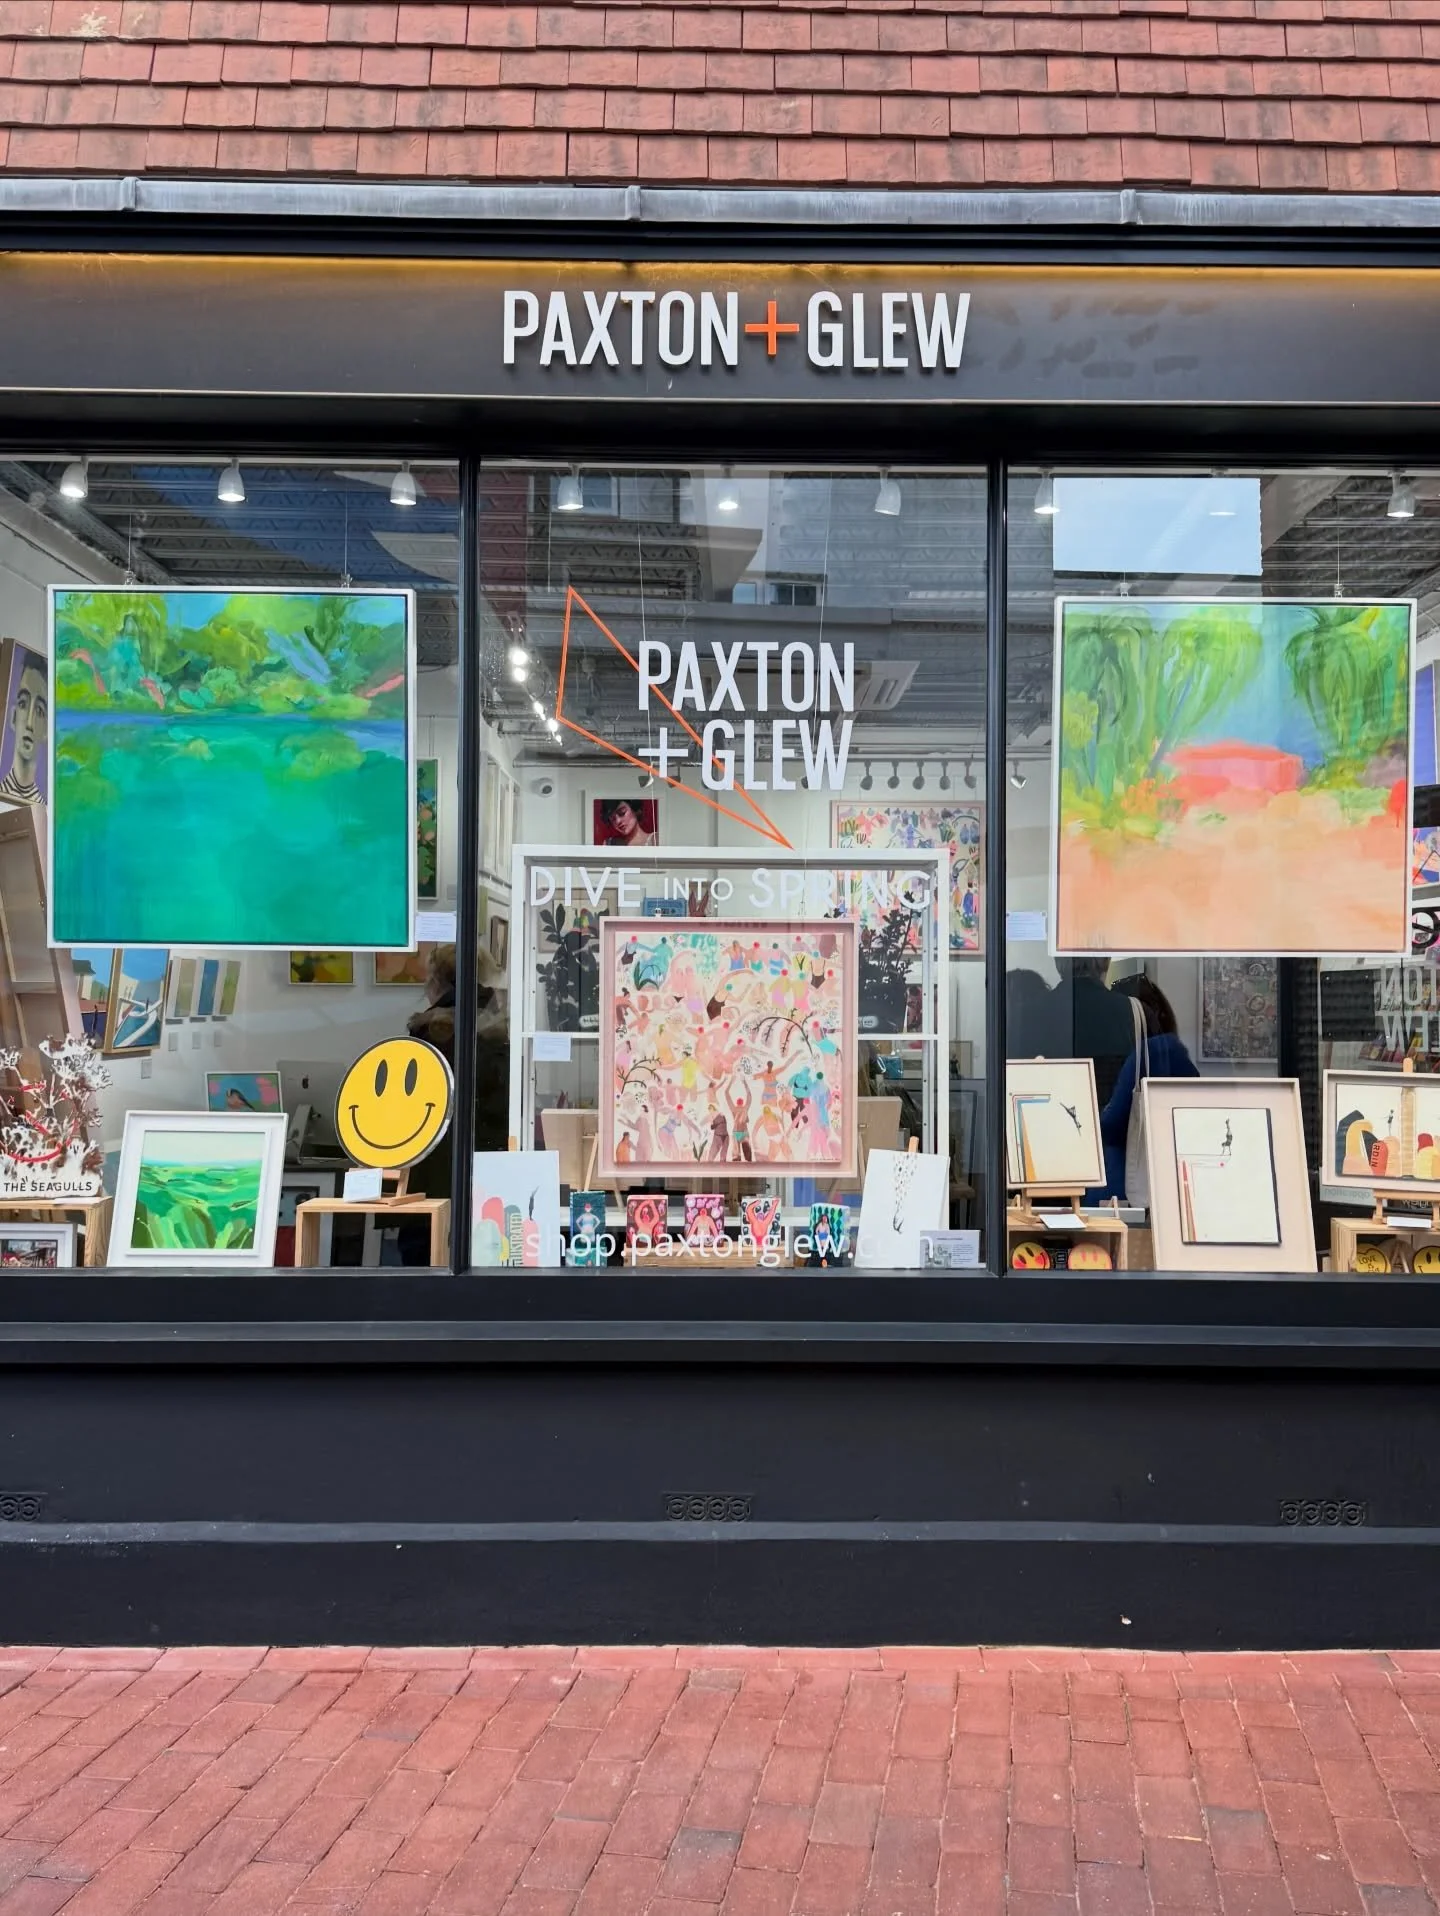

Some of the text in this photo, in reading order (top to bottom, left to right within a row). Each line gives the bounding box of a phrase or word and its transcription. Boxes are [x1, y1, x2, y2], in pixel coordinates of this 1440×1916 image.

[638, 640, 854, 712] PAXTON
[530, 866, 931, 910] DIVE INTO SPRING
[4, 1181, 92, 1192] THE SEAGULLS
[526, 1224, 934, 1267] shop.paxtonglew.c
